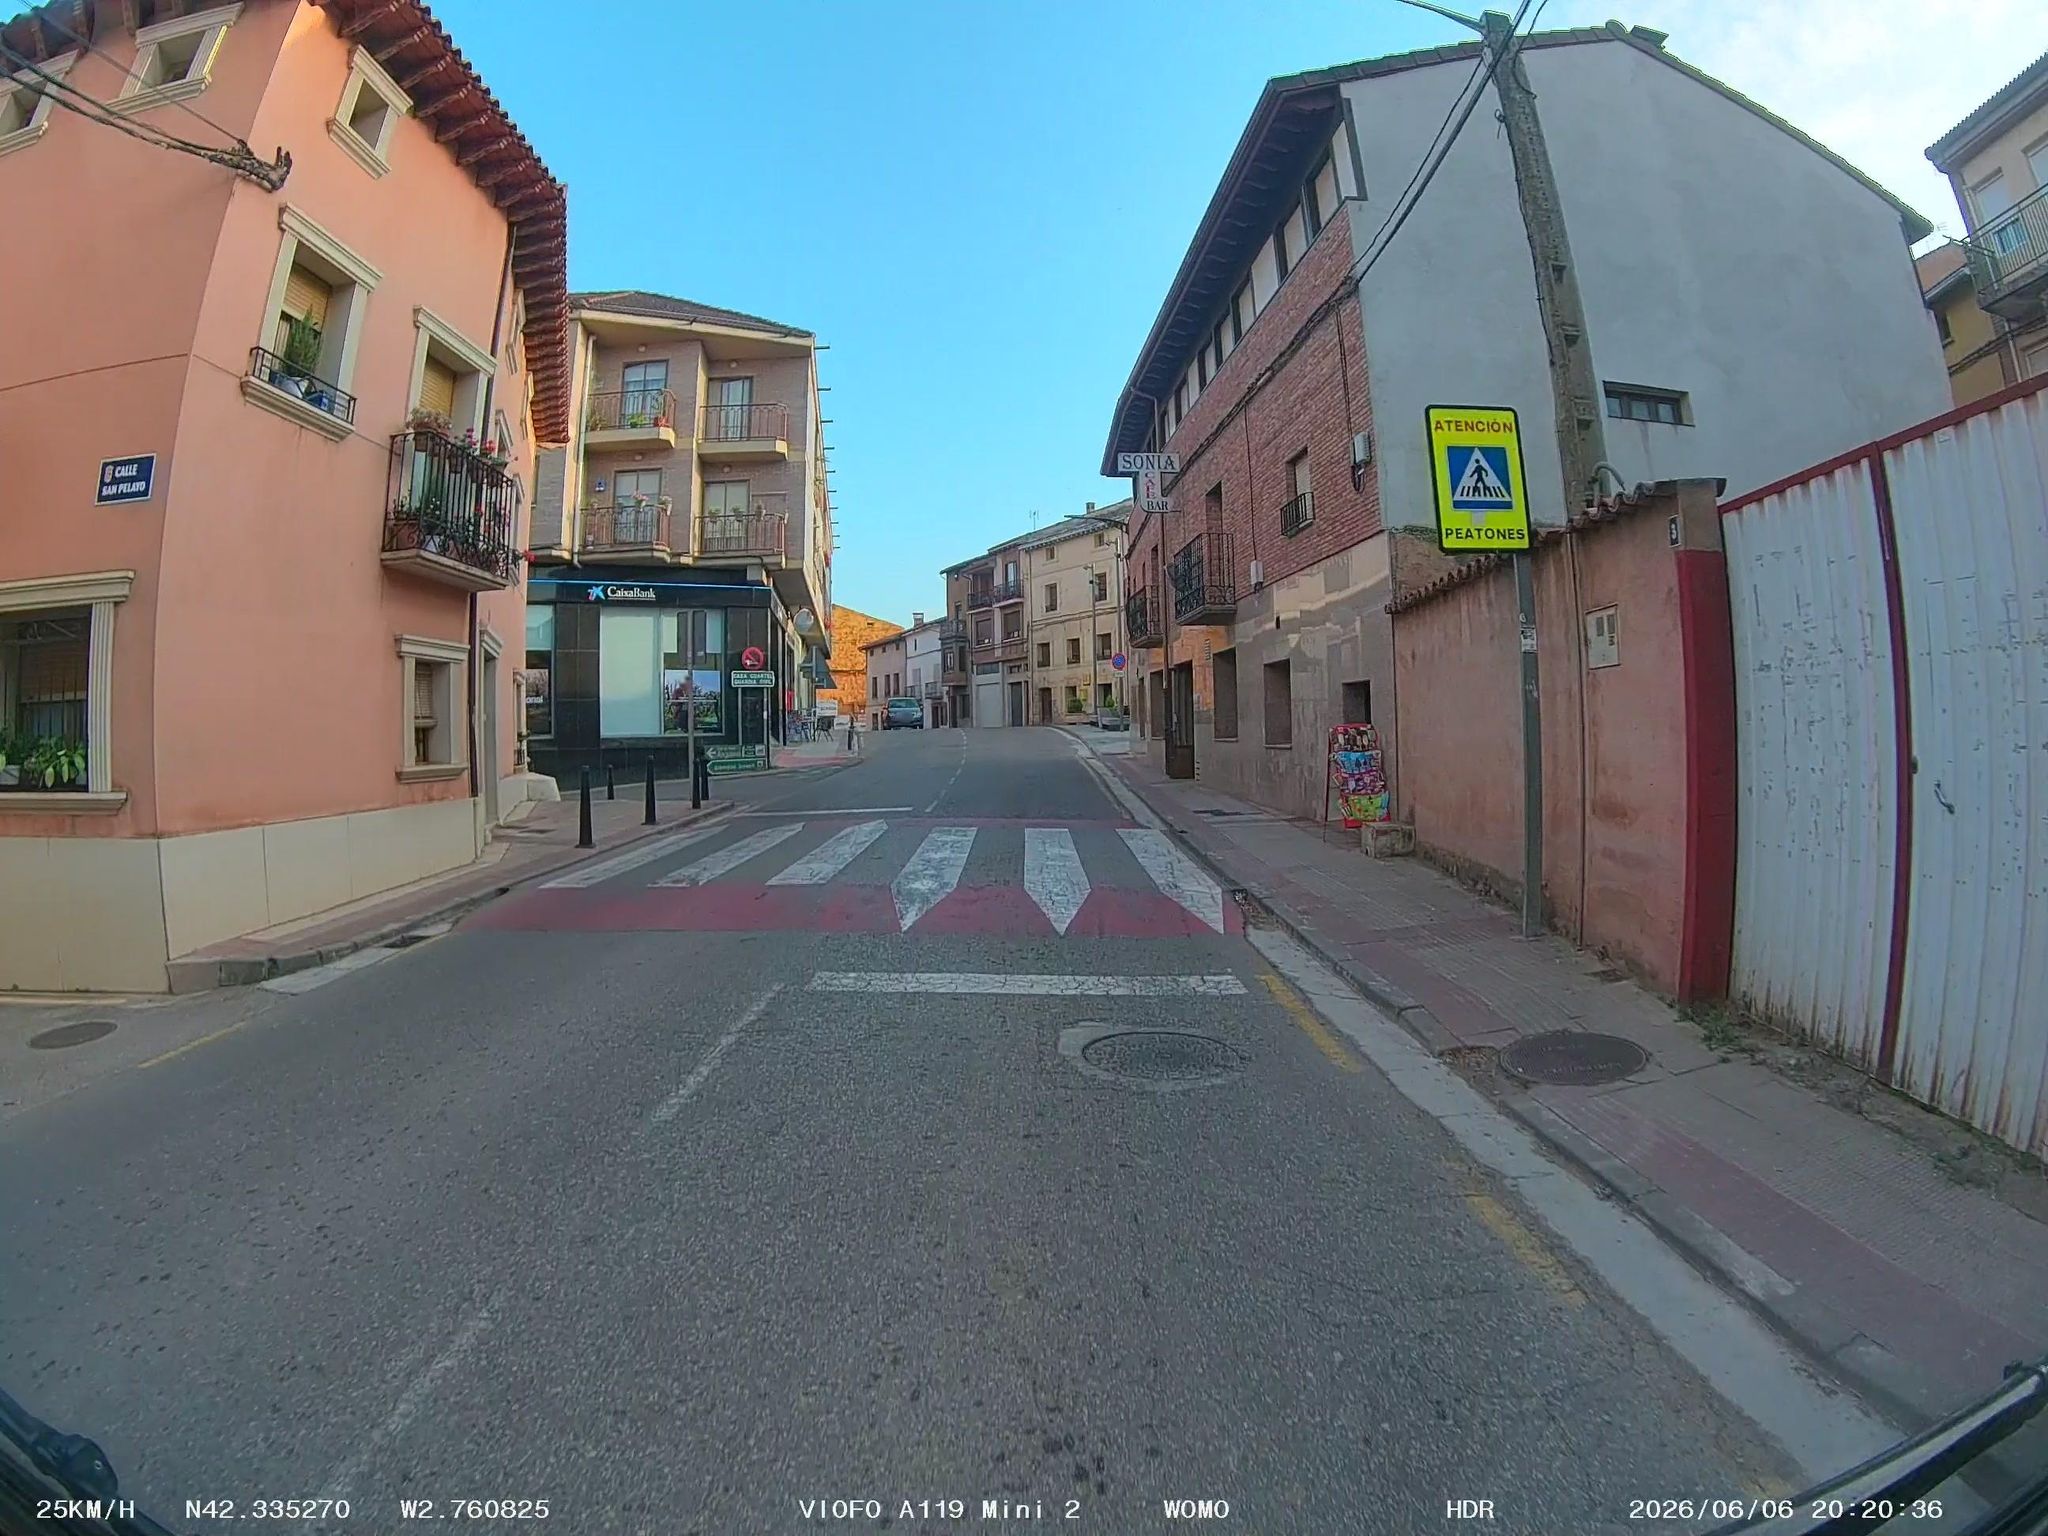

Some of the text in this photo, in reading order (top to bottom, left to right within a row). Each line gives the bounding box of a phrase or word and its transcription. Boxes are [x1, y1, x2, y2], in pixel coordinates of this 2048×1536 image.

[1434, 418, 1513, 433] ATENCIÓN
[1122, 454, 1175, 470] SONIA
[114, 464, 138, 478] CALLE
[102, 481, 146, 496] SAN PELAYO
[1147, 501, 1169, 510] BAR
[1445, 527, 1525, 540] PEATONES
[607, 586, 656, 598] CaixaBank
